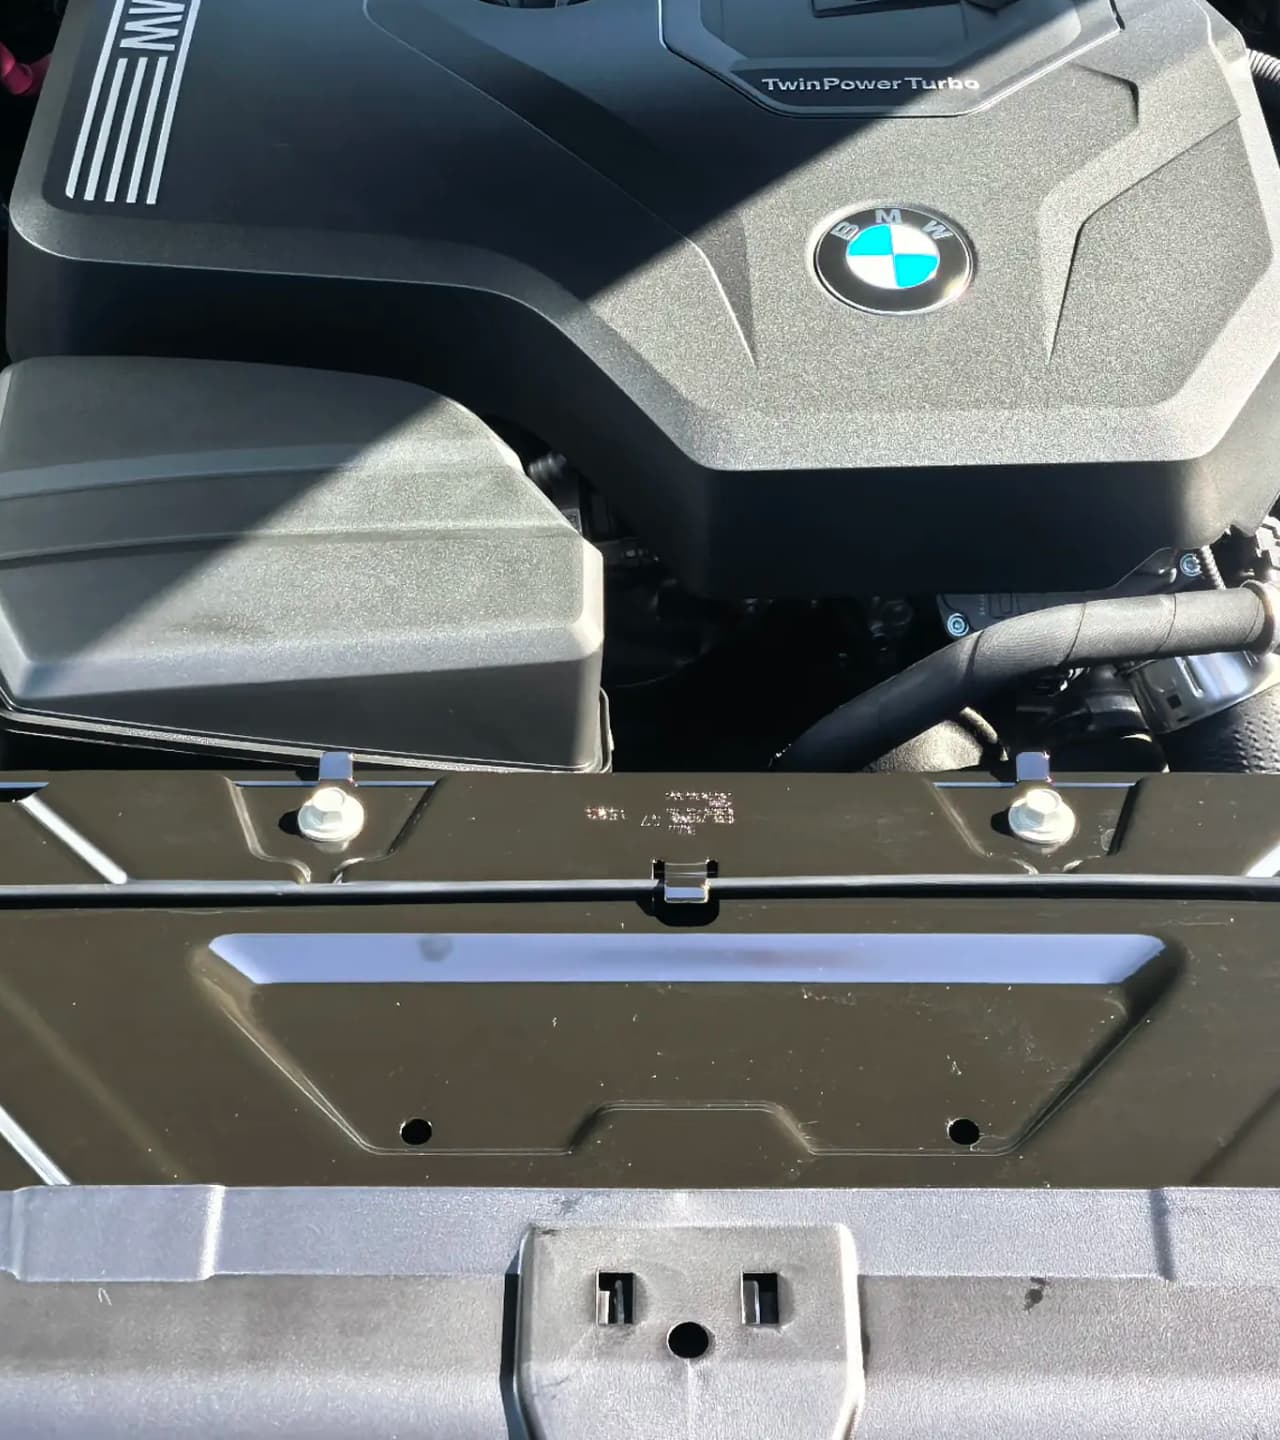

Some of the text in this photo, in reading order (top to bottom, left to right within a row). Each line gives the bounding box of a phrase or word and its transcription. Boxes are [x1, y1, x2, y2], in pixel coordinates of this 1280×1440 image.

[761, 77, 980, 91] TwinPower Turbo
[830, 209, 954, 241] BMW
